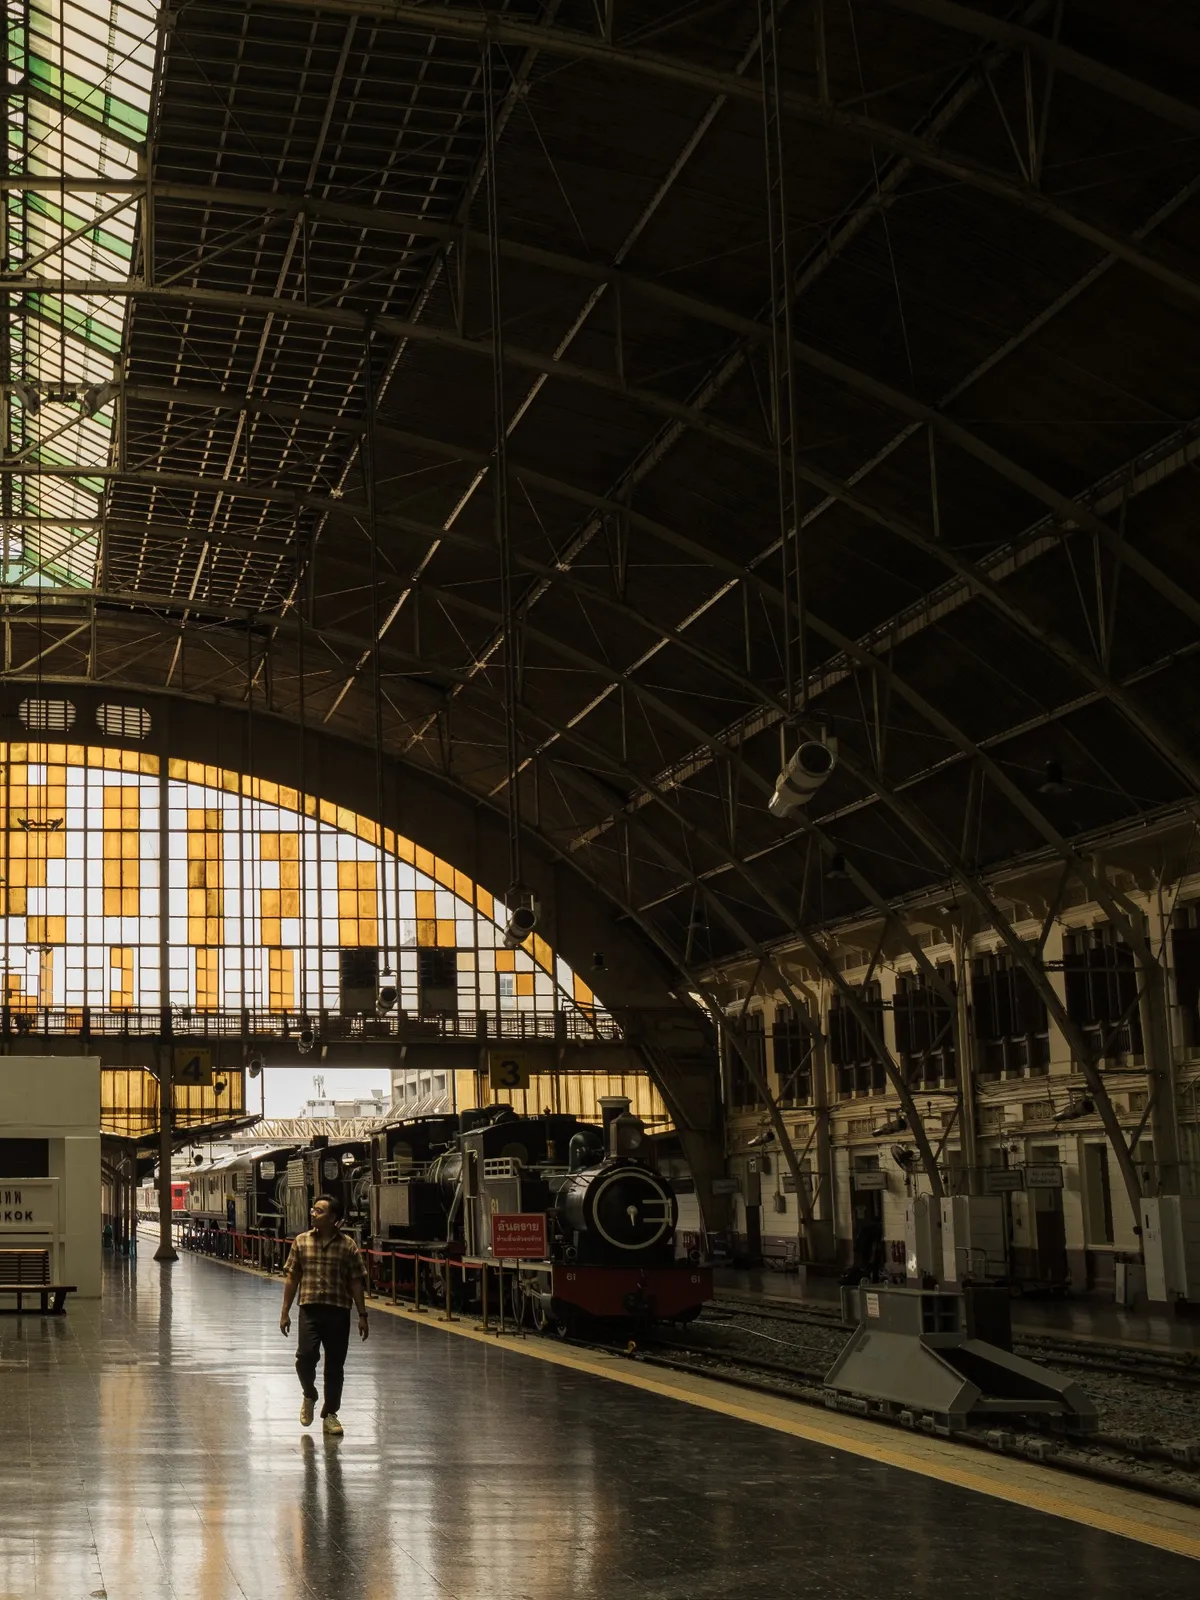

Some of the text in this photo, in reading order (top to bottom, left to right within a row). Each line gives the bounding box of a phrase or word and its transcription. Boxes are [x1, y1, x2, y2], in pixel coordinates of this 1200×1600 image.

[182, 1056, 203, 1082] 4
[500, 1060, 520, 1087] 3
[497, 1220, 540, 1231] อันตราย
[566, 1272, 576, 1281] 61
[690, 1275, 701, 1284] 61
